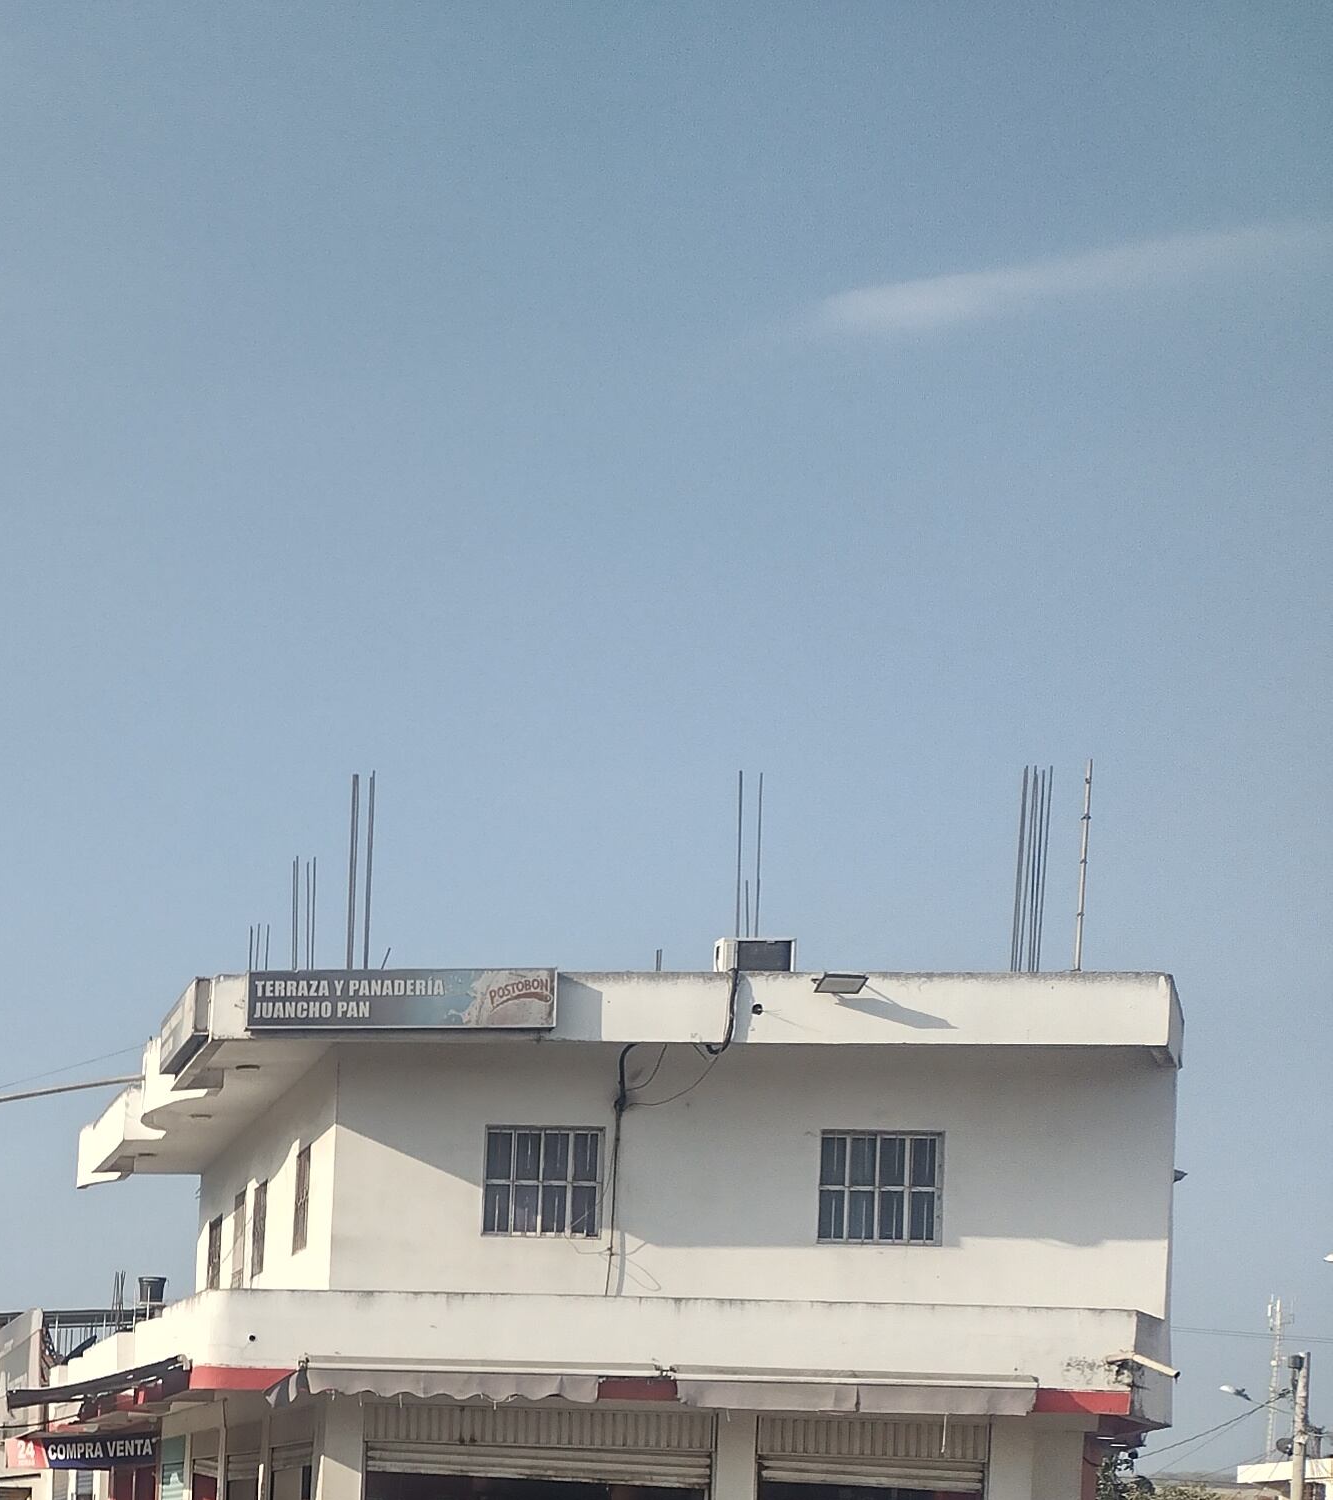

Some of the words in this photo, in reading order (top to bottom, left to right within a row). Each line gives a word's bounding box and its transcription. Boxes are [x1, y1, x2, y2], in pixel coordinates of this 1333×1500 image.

[255, 980, 330, 997] TERRAZA
[333, 980, 344, 996] Y
[349, 976, 445, 996] PANADERÍA
[489, 979, 549, 1006] POSTOBON
[254, 1002, 332, 1018] JUANCHO
[337, 1002, 370, 1018] PAN
[48, 1442, 103, 1461] COMPRA
[107, 1439, 153, 1457] VENTA
